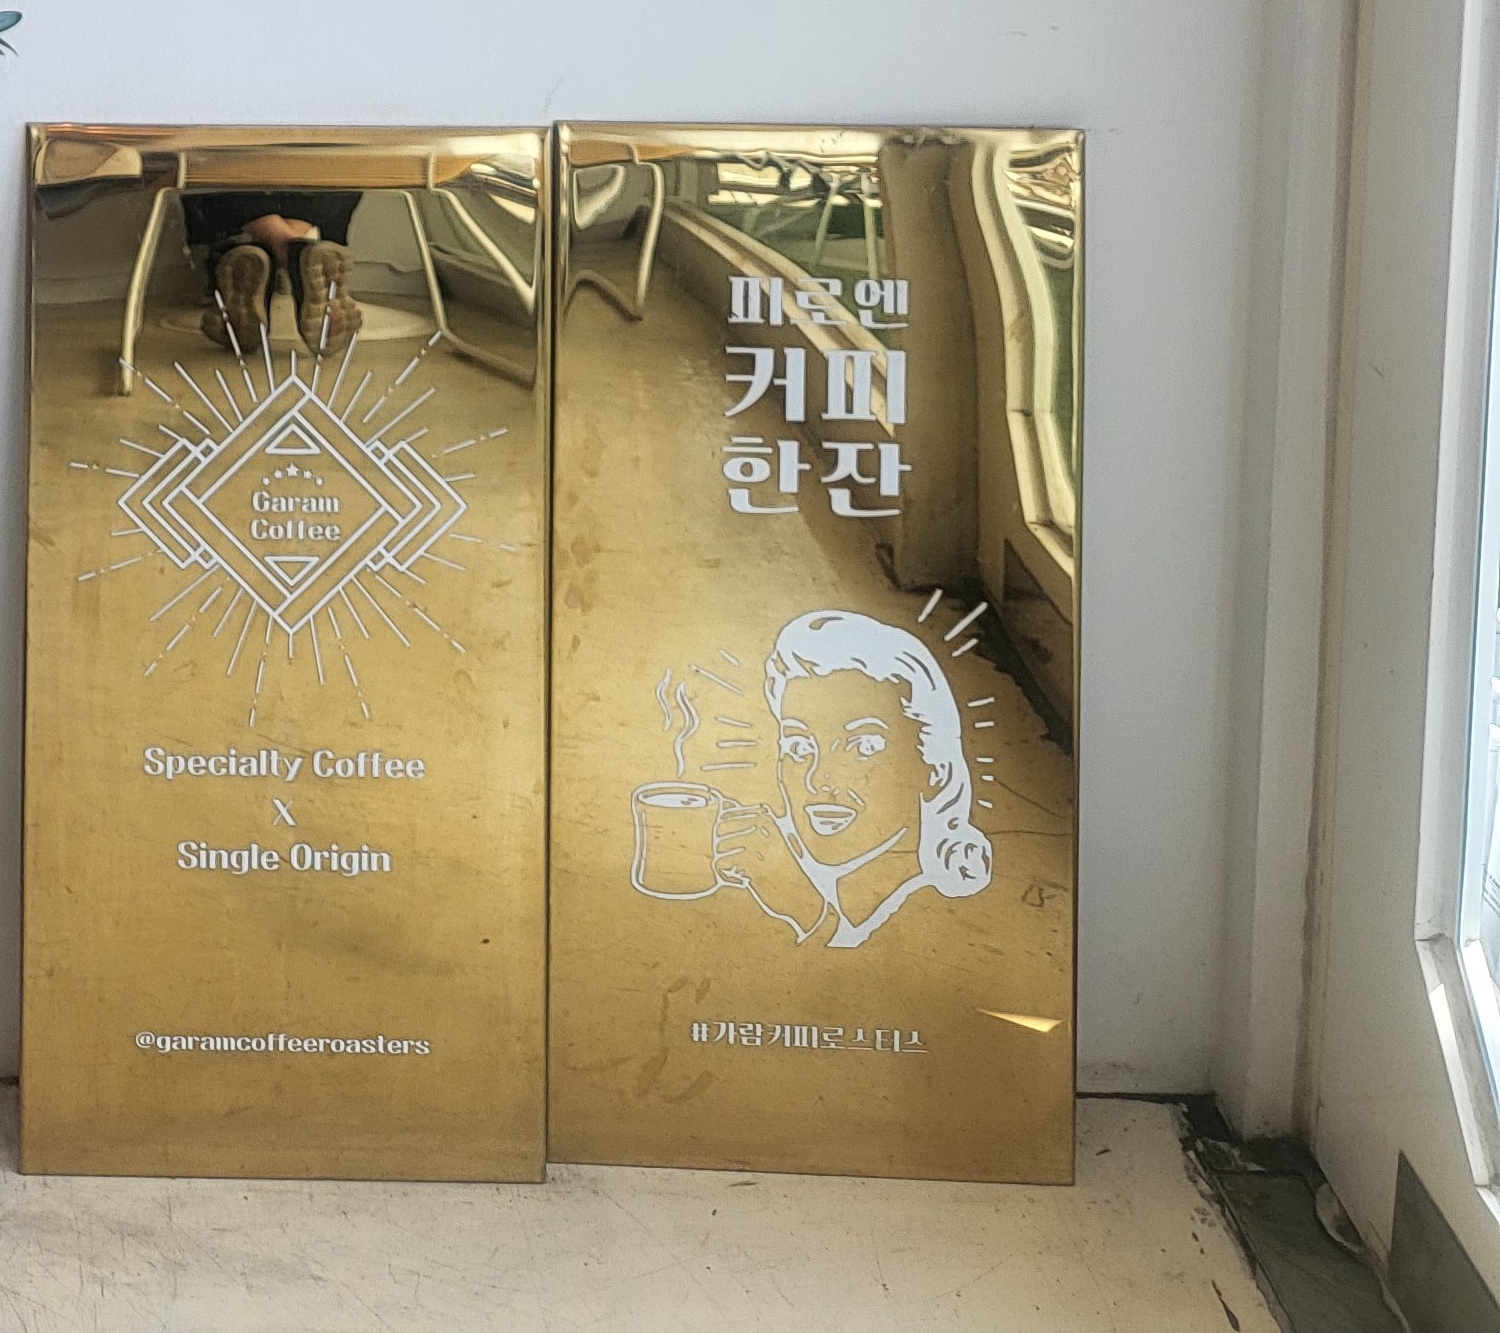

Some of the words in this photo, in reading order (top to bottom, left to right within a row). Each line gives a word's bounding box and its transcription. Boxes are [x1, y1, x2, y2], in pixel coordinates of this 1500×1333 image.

[727, 275, 911, 329] 피로엔
[723, 346, 907, 425] 커피
[721, 436, 913, 518] 한잔
[251, 490, 341, 514] Garam
[250, 518, 342, 541] Coffee
[143, 747, 303, 782] Specialty
[312, 749, 426, 780] Coffee
[176, 841, 281, 876] Single
[289, 843, 393, 877] Origin
[134, 1030, 431, 1055] @garamcoffeeroasters
[690, 1021, 930, 1054] #가람커피로스터스
